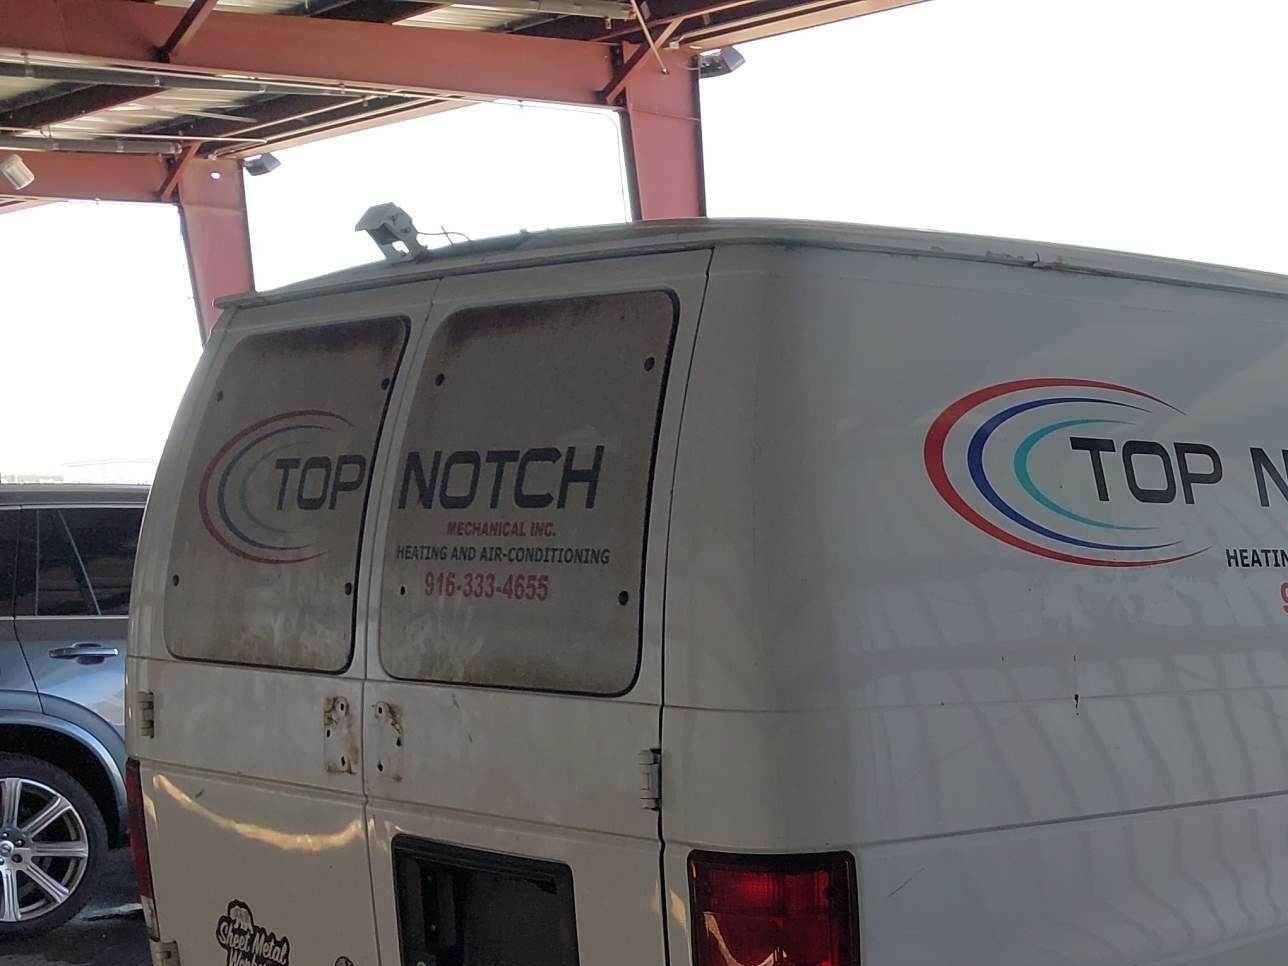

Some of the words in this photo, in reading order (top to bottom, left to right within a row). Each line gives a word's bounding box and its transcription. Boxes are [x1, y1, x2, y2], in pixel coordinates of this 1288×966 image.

[274, 455, 366, 510] TOP
[398, 446, 605, 509] NOTCH
[1070, 437, 1223, 504] TOP
[446, 520, 526, 537] MECHANICAL
[530, 522, 556, 537] INC.
[397, 545, 447, 560] HEATING
[451, 546, 475, 561] AND
[480, 547, 610, 564] AIR-CONDITIONING
[424, 572, 549, 600] 916-333-4655
[219, 921, 251, 953] Sheet
[252, 931, 288, 965] Metal
